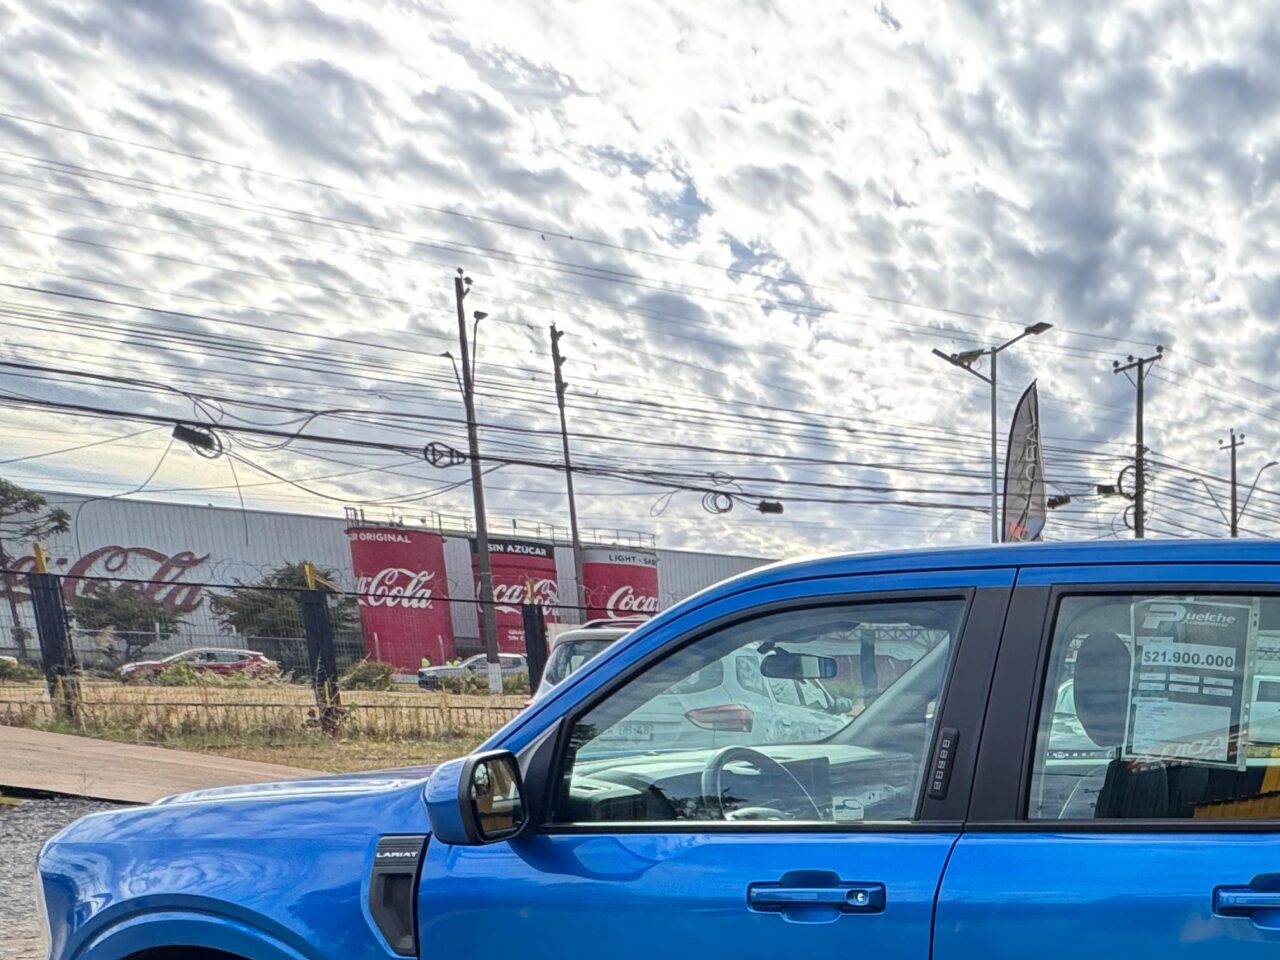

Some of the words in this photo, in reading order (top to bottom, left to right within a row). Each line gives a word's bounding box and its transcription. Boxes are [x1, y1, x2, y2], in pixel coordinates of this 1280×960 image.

[359, 533, 412, 543] ORIGINAL
[487, 543, 504, 552] SIN
[608, 554, 636, 562] LIGHT
[1144, 651, 1234, 668] $21.900.000
